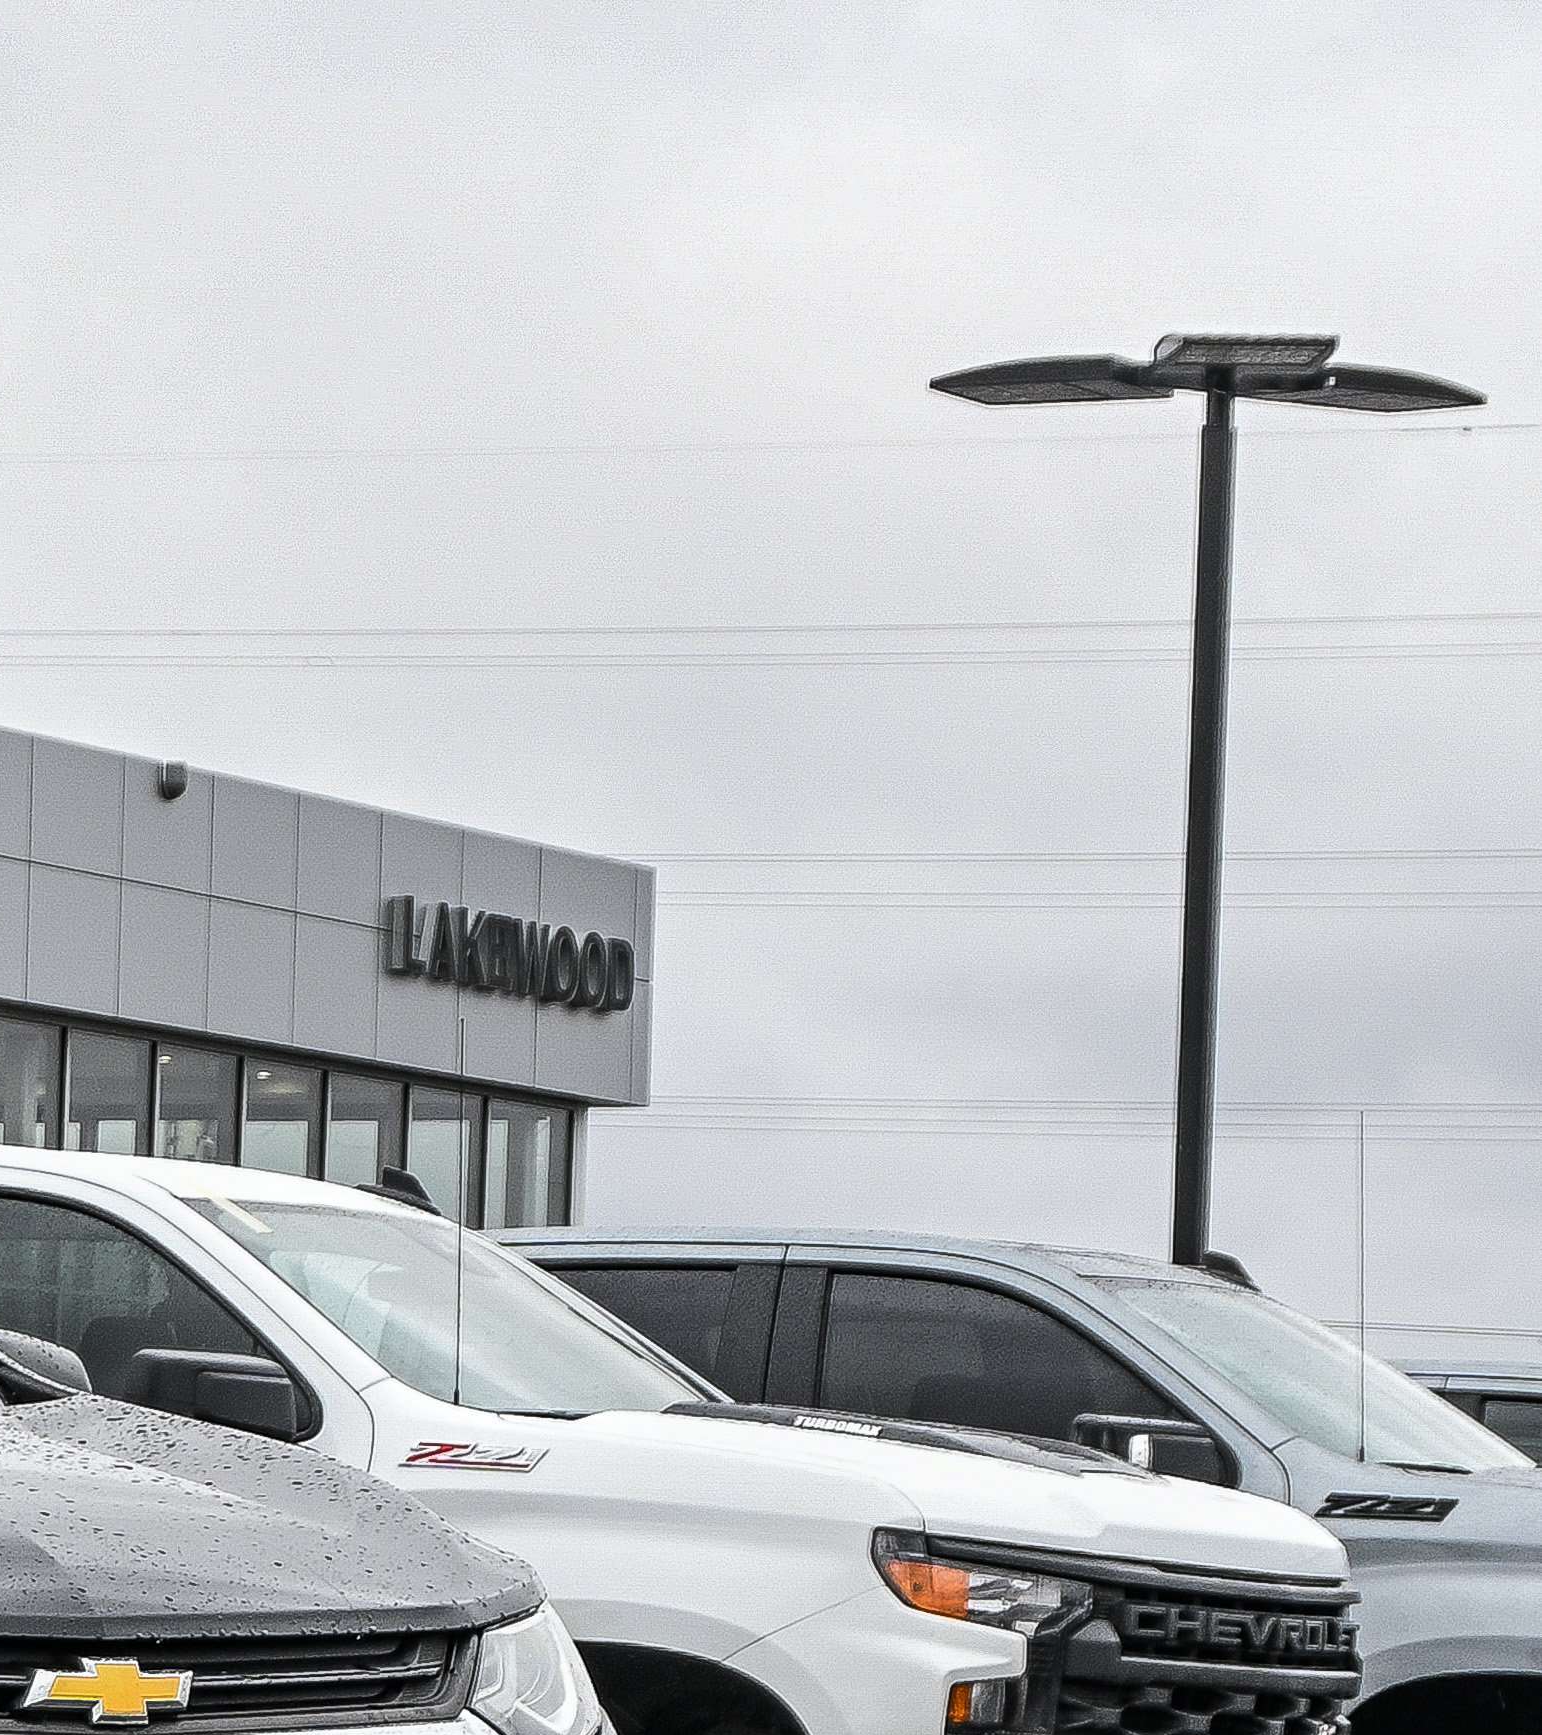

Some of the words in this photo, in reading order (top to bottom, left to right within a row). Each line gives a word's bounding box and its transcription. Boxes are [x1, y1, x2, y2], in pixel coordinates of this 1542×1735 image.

[385, 894, 635, 1012] LAKEWOOD
[794, 1415, 884, 1438] TURBOMAX
[1125, 1601, 1361, 1652] CHEVROLET
